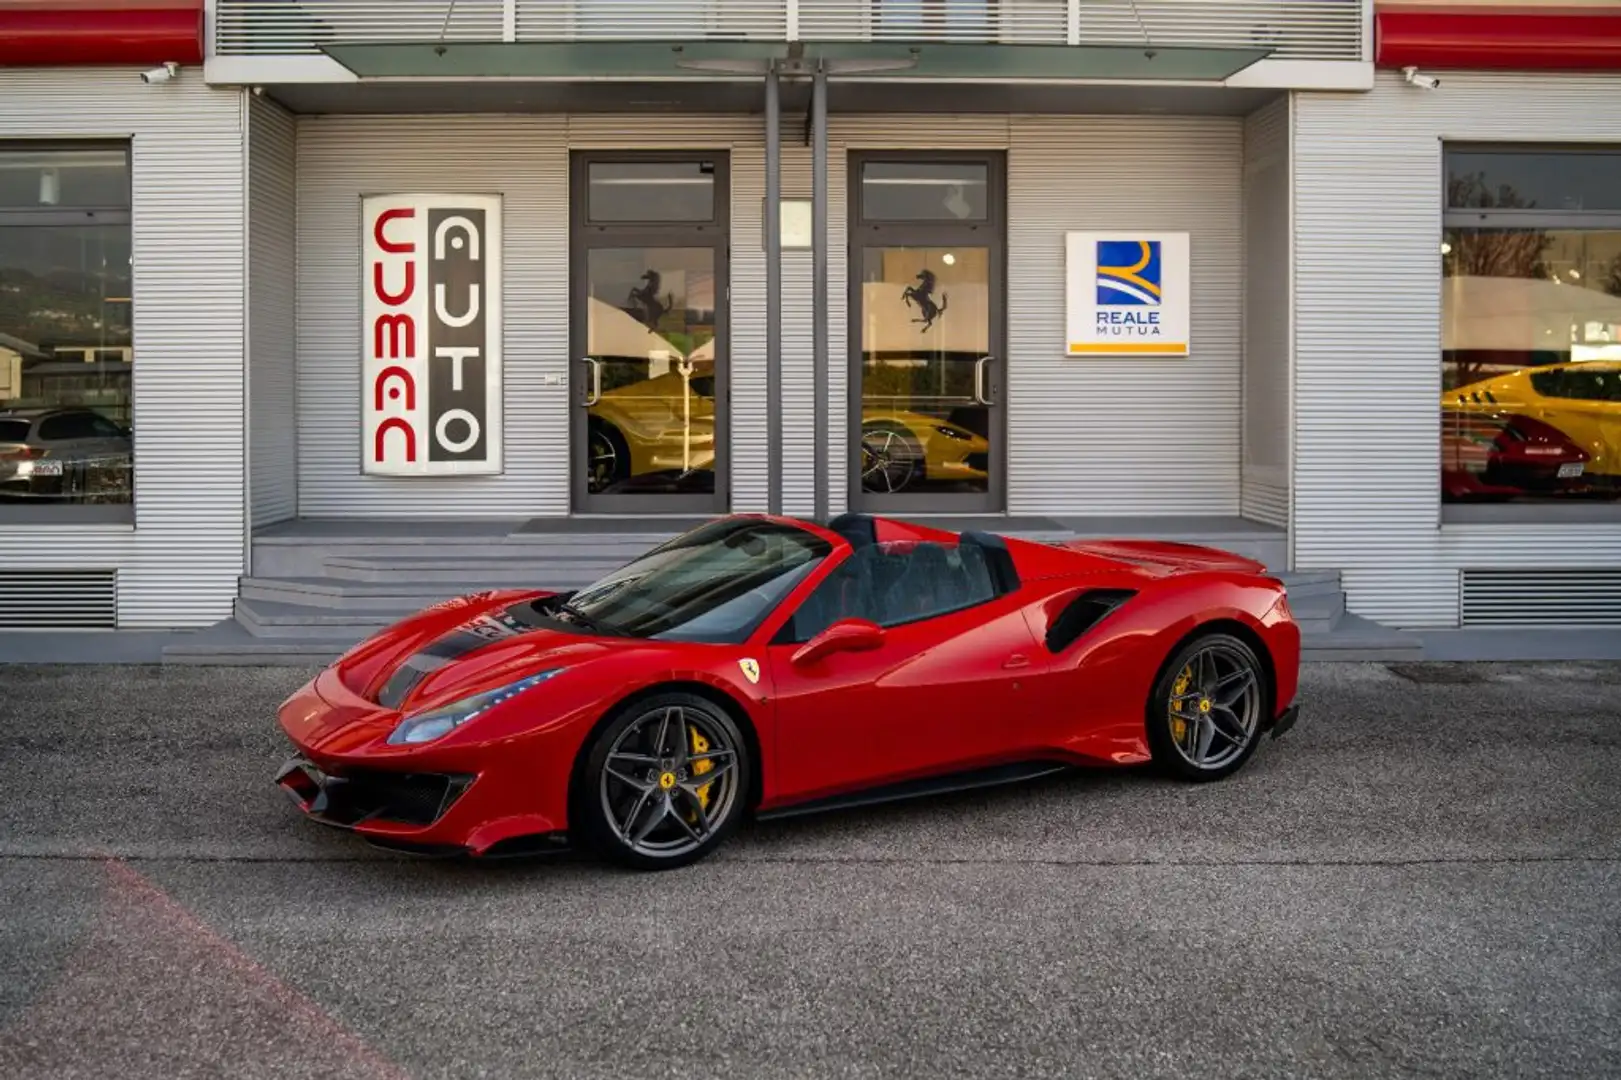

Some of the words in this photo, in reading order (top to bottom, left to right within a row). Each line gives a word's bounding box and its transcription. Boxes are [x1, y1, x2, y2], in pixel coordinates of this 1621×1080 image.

[374, 208, 416, 462] CUMAN
[435, 216, 480, 453] AUTO
[1096, 311, 1160, 324] REALE
[1096, 326, 1160, 335] MUTUA
